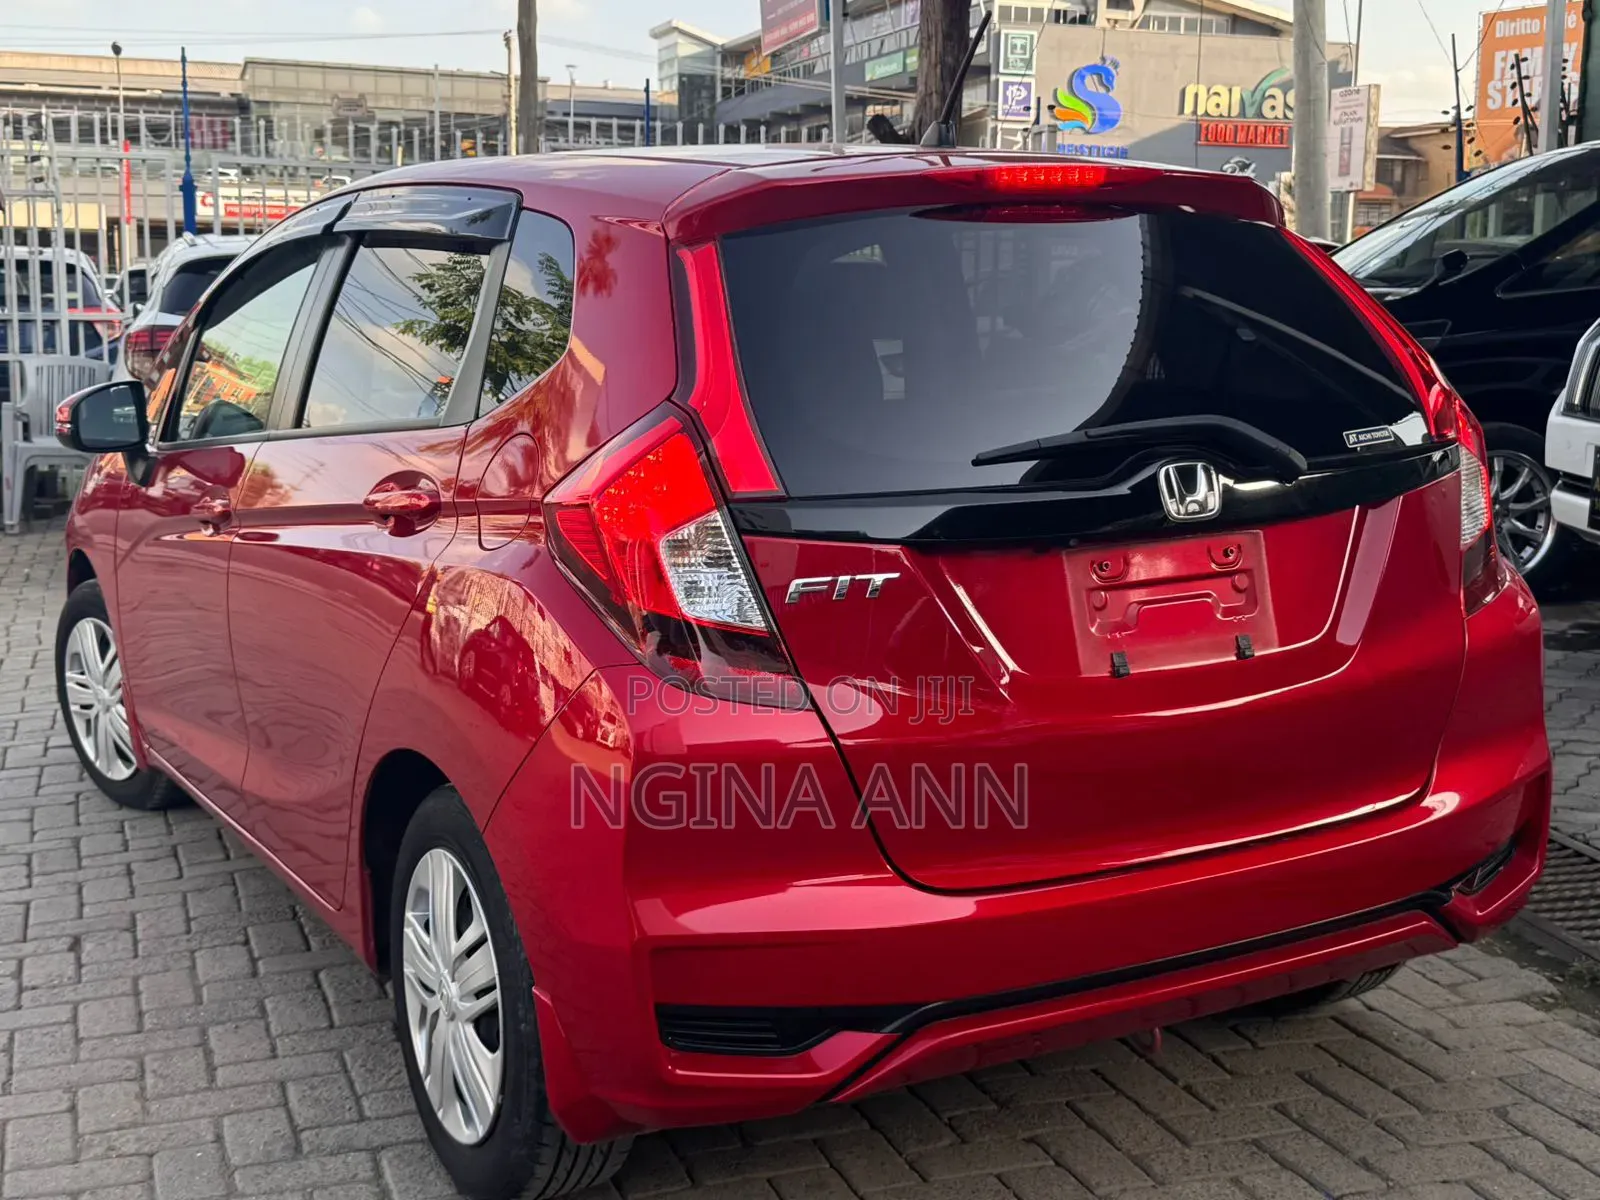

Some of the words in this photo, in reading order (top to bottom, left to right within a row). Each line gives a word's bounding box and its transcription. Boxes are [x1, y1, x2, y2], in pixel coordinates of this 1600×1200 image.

[1495, 17, 1541, 38] Diritto
[1493, 42, 1578, 81] FAMY
[1200, 122, 1235, 143] FOOD
[1236, 123, 1290, 145] MARKET
[1372, 430, 1389, 439] TOYOTA
[785, 573, 900, 604] FIT
